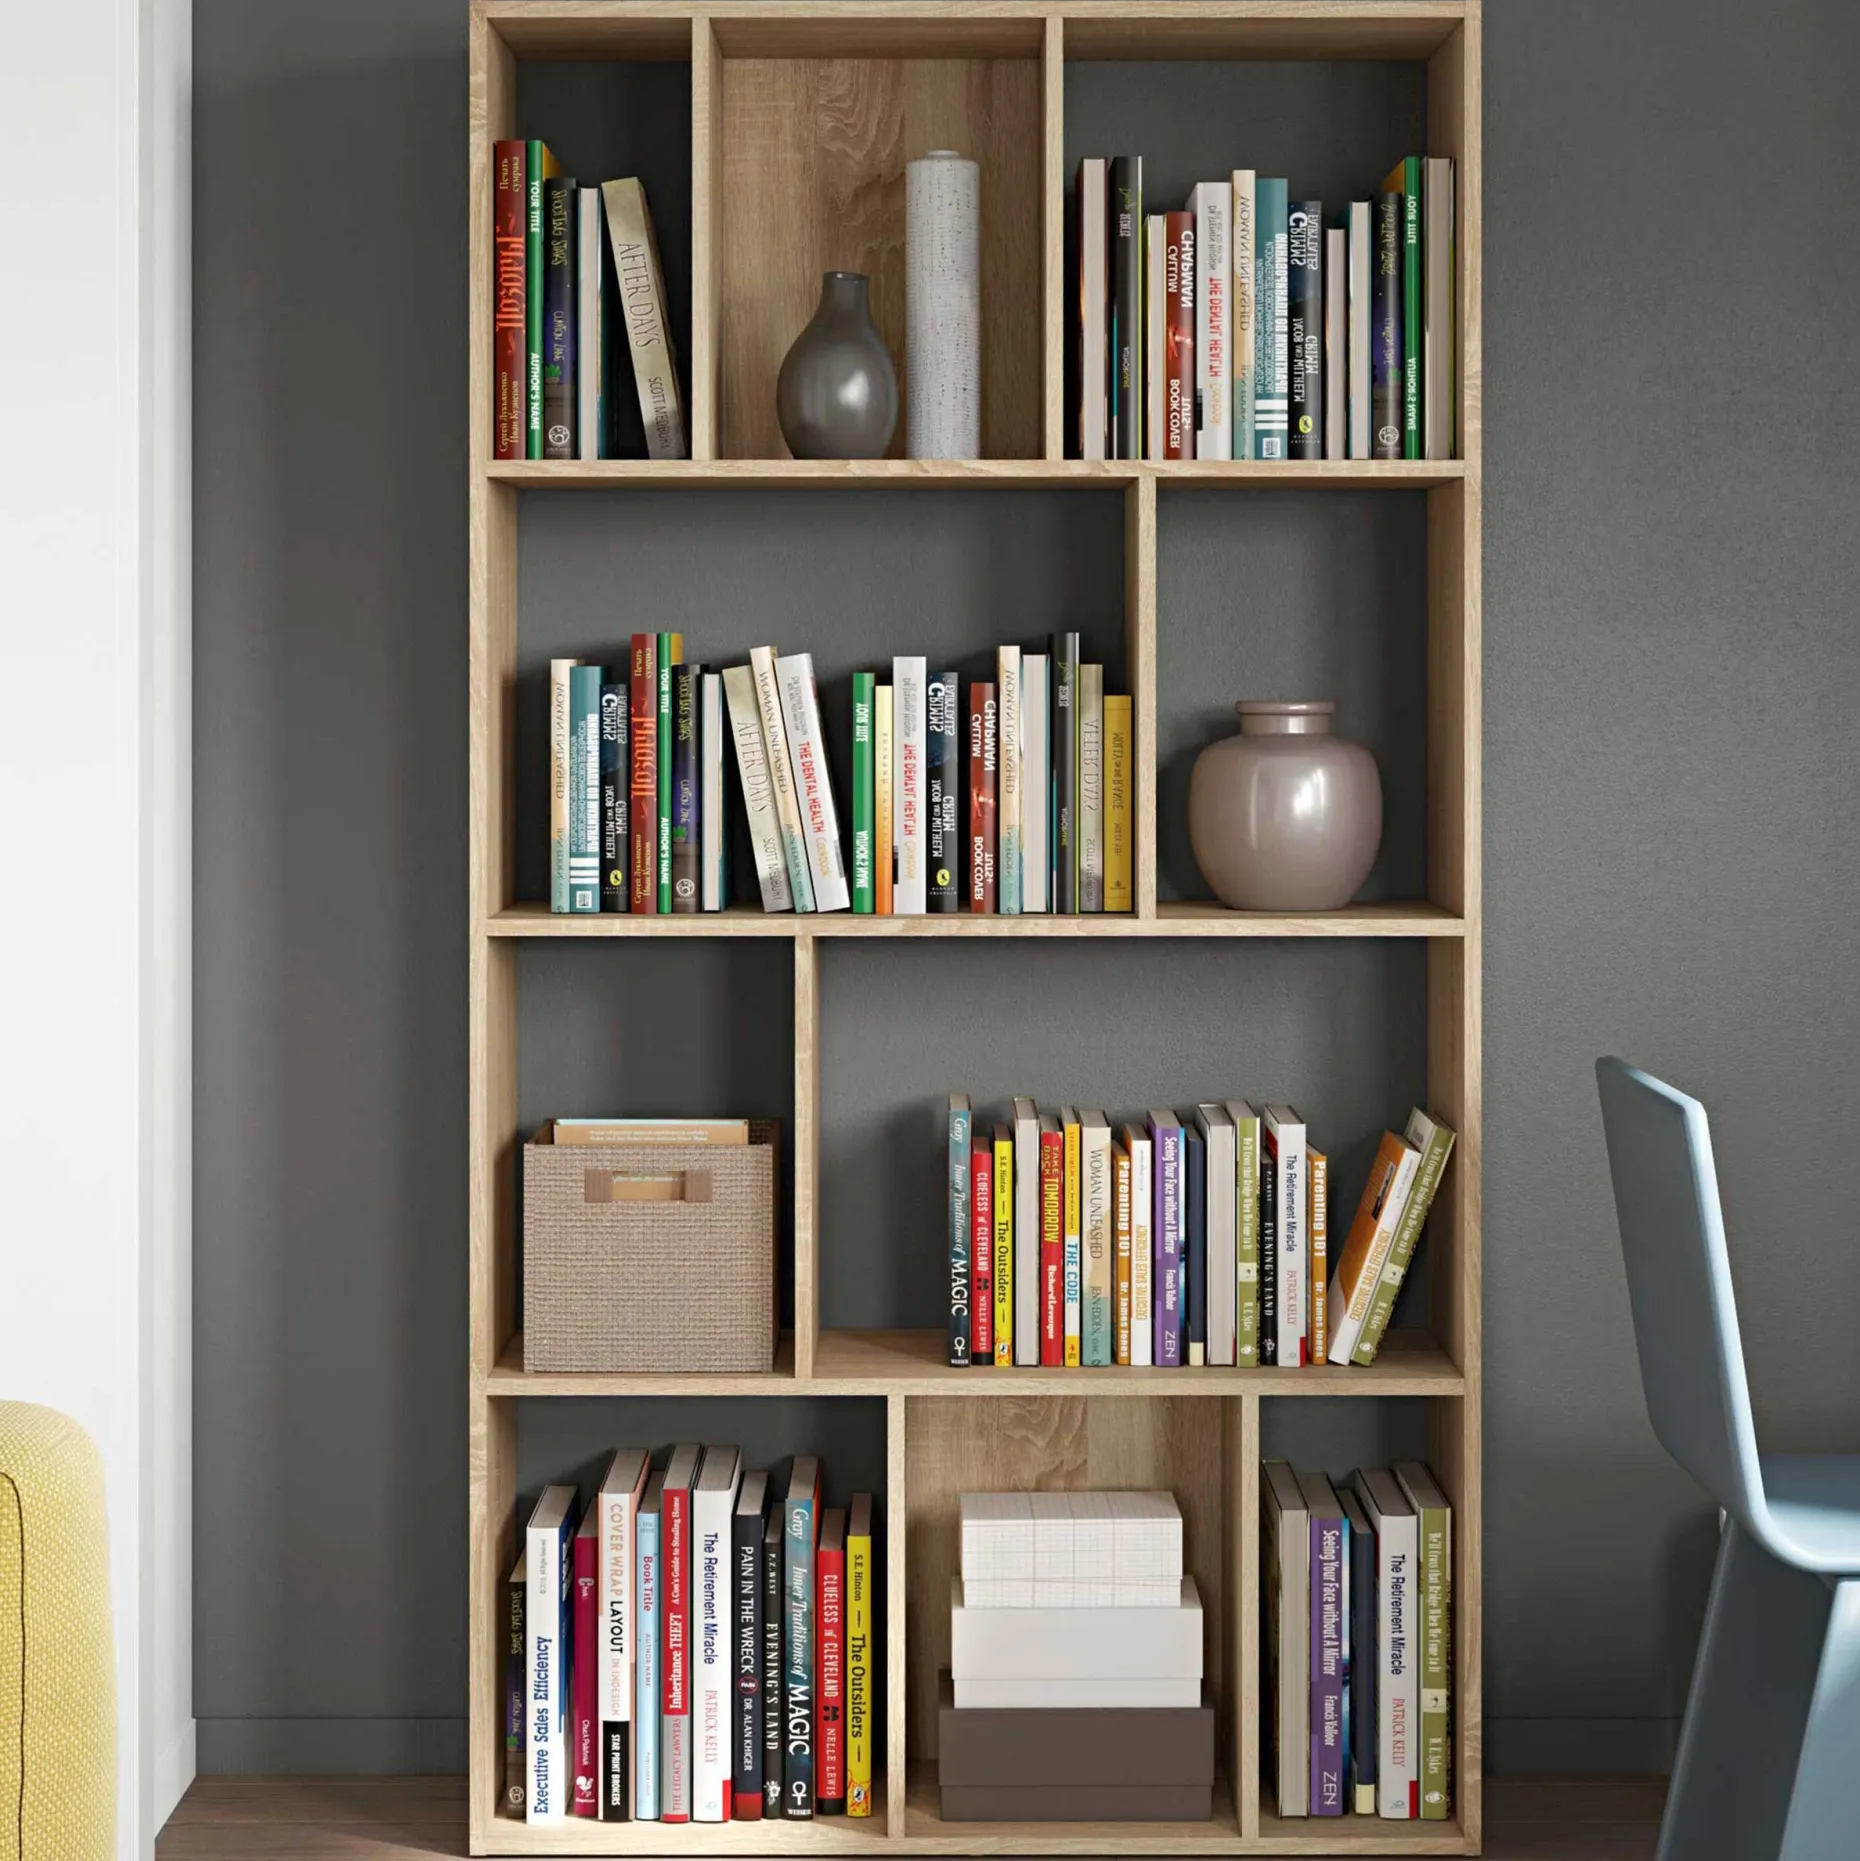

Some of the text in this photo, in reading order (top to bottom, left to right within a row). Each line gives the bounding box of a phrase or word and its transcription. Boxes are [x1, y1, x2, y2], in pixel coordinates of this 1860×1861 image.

[530, 180, 540, 233] YOUR TITLE
[618, 243, 661, 348] AFTER DAYS
[530, 353, 540, 430] AUTHOR'S NAME
[649, 376, 665, 404] SCOTT
[661, 668, 670, 713] YOUR TITLE
[759, 671, 788, 794] WOMAN UNLEASHED
[737, 721, 772, 813] AFTER DAYS
[799, 741, 825, 834] THE DENTAL HEALTH
[661, 861, 670, 885] NAME
[762, 838, 780, 862] SCOTT
[951, 1118, 967, 1144] Gray
[1161, 1137, 1177, 1161] Seeing
[999, 1170, 1008, 1194] Hinton
[1164, 1161, 1177, 1179] Your
[1164, 1179, 1177, 1198] Face
[977, 1172, 988, 1271] CLUELESS CLEVELAND
[1043, 1178, 1059, 1243] TOMORROW
[1090, 1149, 1102, 1259] WOMAN UNLEASHED
[1117, 1161, 1130, 1257] Parenting 101
[1286, 1155, 1297, 1252] The Retirement Miracle
[1313, 1161, 1326, 1257] Parenting 101
[998, 1220, 1009, 1303] The Outsiders
[1066, 1243, 1078, 1267] THE
[1164, 1230, 1177, 1254] Mirror
[951, 1258, 967, 1317] MAGIC
[1066, 1271, 1078, 1304] CODE
[1264, 1288, 1274, 1316] LAND
[1287, 1270, 1297, 1325] PATRICK KELLY
[1120, 1297, 1129, 1328] James
[1315, 1297, 1324, 1328] James
[1120, 1329, 1129, 1357] Jones
[1164, 1331, 1175, 1358] ZEN
[1315, 1330, 1324, 1357] Jones
[610, 1504, 623, 1551] COVER
[671, 1497, 680, 1518] Home
[1320, 1530, 1339, 1559] Seeing
[610, 1555, 623, 1597] WRAP
[643, 1556, 654, 1611] Book Title
[854, 1572, 863, 1601] Hinton
[1323, 1560, 1339, 1581] Your
[1323, 1582, 1339, 1603] Face
[704, 1532, 717, 1664] The Retirement Miracle
[741, 1546, 754, 1673] PAIN IN THE WRECK
[1323, 1604, 1339, 1638] without
[1391, 1555, 1406, 1675] The Retirement Miracle
[610, 1601, 623, 1653] LAYOUT
[788, 1508, 809, 1755] Gray Inner Traditions of MAGIC
[823, 1574, 838, 1697] CLUELESS CLEVELAND
[669, 1613, 682, 1709] Inheritance THEFT
[1323, 1648, 1339, 1675] Mirror
[611, 1672, 621, 1716] INDESIGN
[765, 1623, 778, 1750] EVENING'S LAND
[851, 1634, 866, 1738] The Outsiders
[1324, 1695, 1337, 1720] Francis
[533, 1636, 552, 1814] Executive Sales Efficiency
[704, 1690, 717, 1764] PATRICK KELLY
[744, 1714, 752, 1737] ALAN
[1392, 1698, 1405, 1767] PATRICK KELLY
[611, 1734, 621, 1806] STAR PRINT BROKERS
[672, 1719, 681, 1811] THE LEGACY LAWYERS
[744, 1739, 752, 1771] KHIGER
[826, 1728, 836, 1796] NELLE LEWIS
[1323, 1771, 1336, 1806] ZEN
